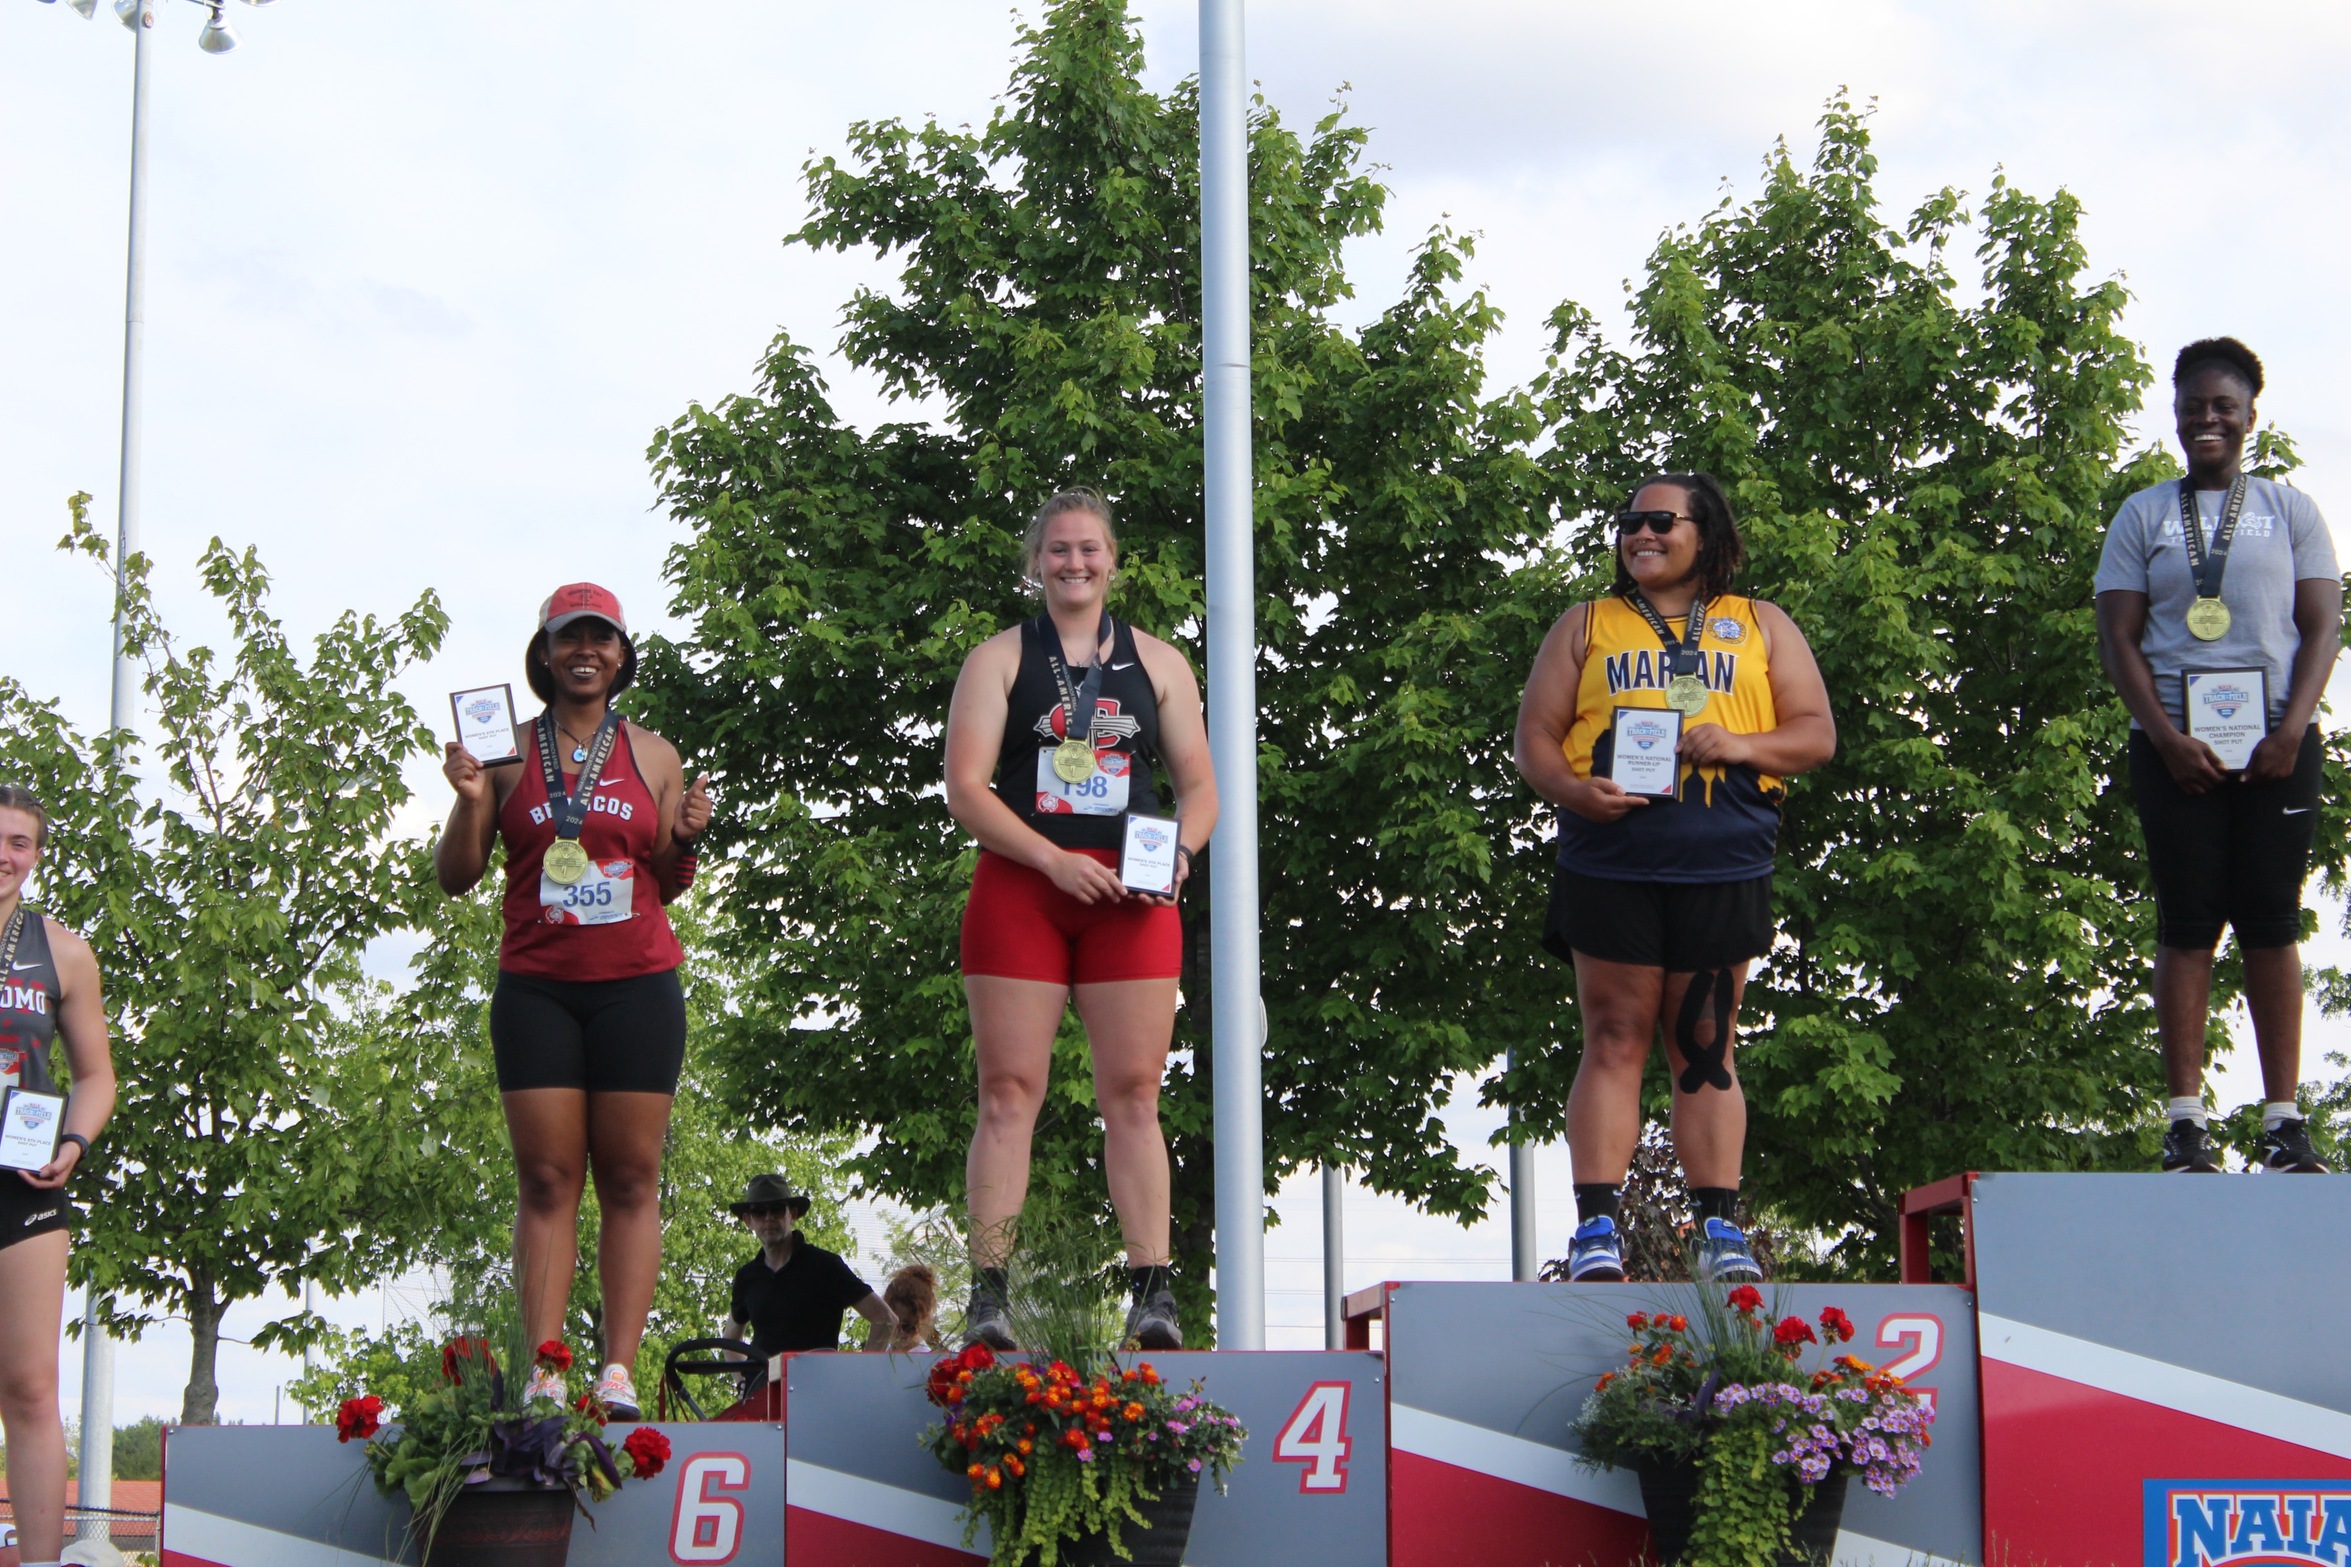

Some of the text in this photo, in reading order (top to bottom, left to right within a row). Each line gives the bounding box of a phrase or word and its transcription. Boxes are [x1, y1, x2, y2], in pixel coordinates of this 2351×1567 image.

[2181, 493, 2199, 566] ALL-AMERICAN
[1604, 650, 1739, 696] MARAN
[580, 727, 614, 806] ALL-AMERICAN
[529, 795, 633, 825] BRCOS
[566, 816, 583, 825] 2024
[562, 882, 612, 907] 355
[38, 1209, 57, 1221] asics
[1874, 1312, 1945, 1424] 2
[1272, 1380, 1352, 1494] 4
[668, 1452, 752, 1566] 6
[2168, 1490, 2351, 1567] NAIA
